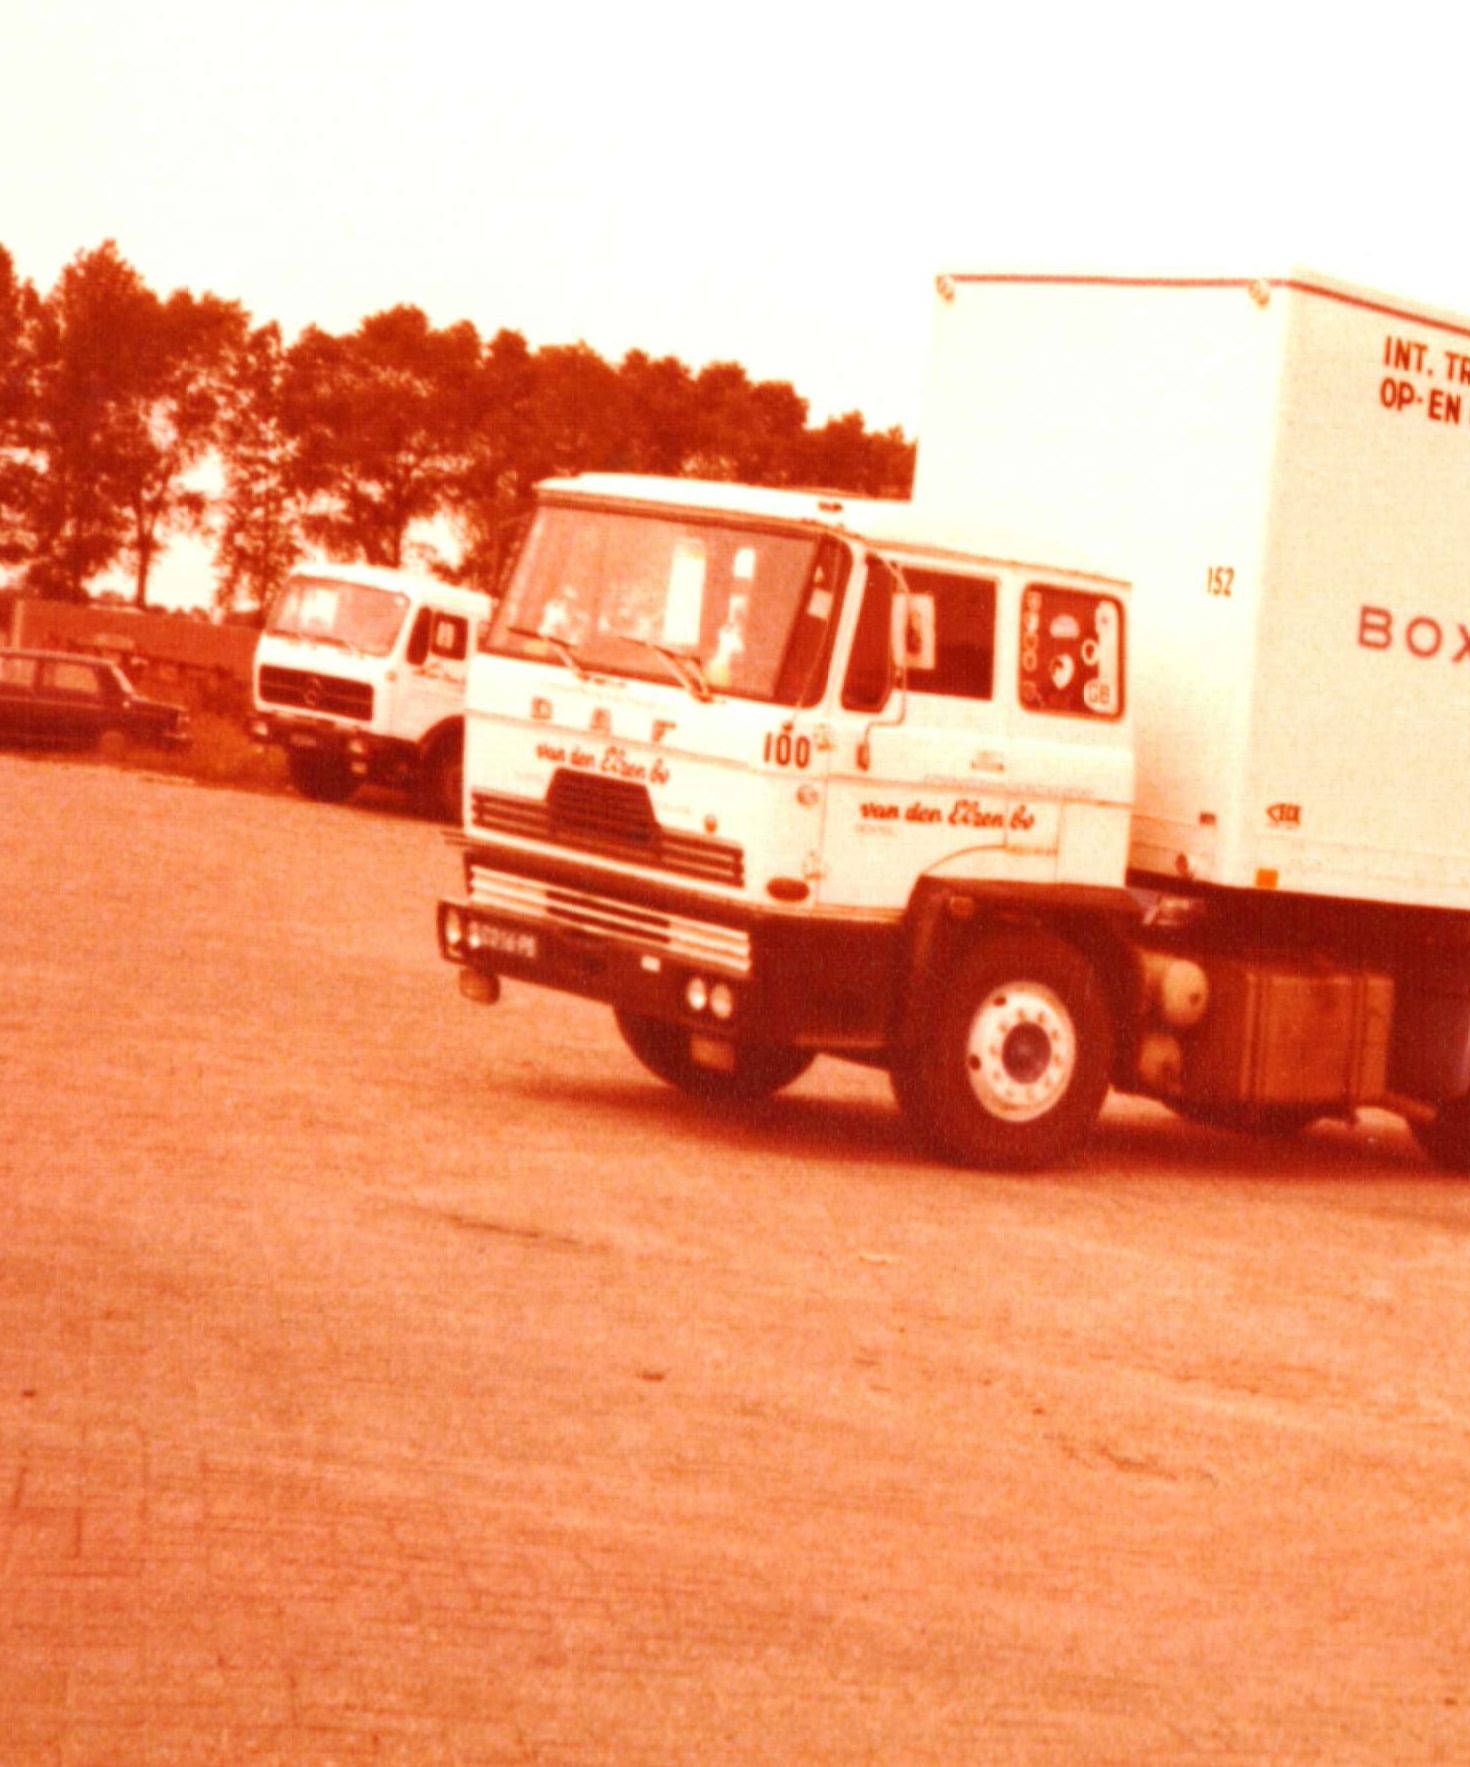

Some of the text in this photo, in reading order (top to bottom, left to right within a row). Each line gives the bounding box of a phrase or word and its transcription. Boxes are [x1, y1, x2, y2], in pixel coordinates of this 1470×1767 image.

[1384, 335, 1433, 377] INT.
[1207, 566, 1235, 597] 152
[763, 731, 812, 769] 100
